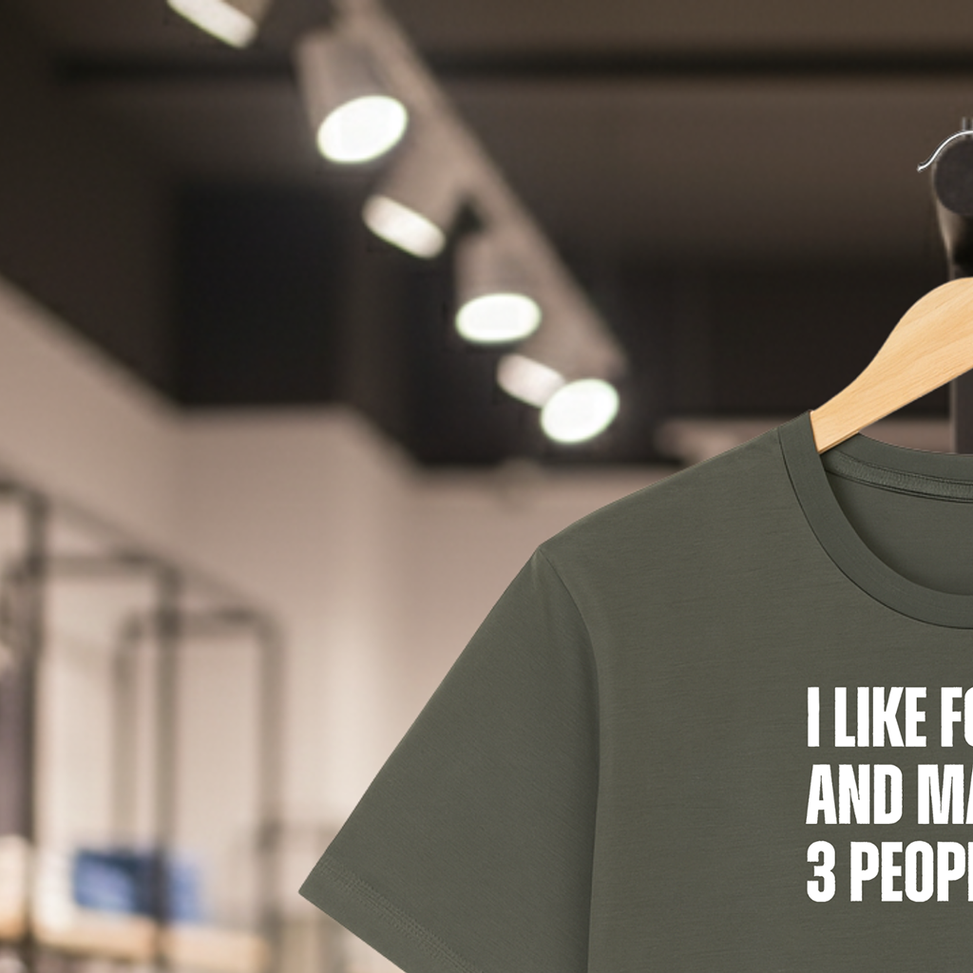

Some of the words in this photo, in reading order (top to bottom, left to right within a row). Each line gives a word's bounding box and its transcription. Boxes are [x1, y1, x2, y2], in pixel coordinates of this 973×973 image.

[807, 686, 820, 747] I
[834, 686, 927, 747] LIKE
[805, 763, 903, 825] AND
[806, 840, 836, 902] 3
